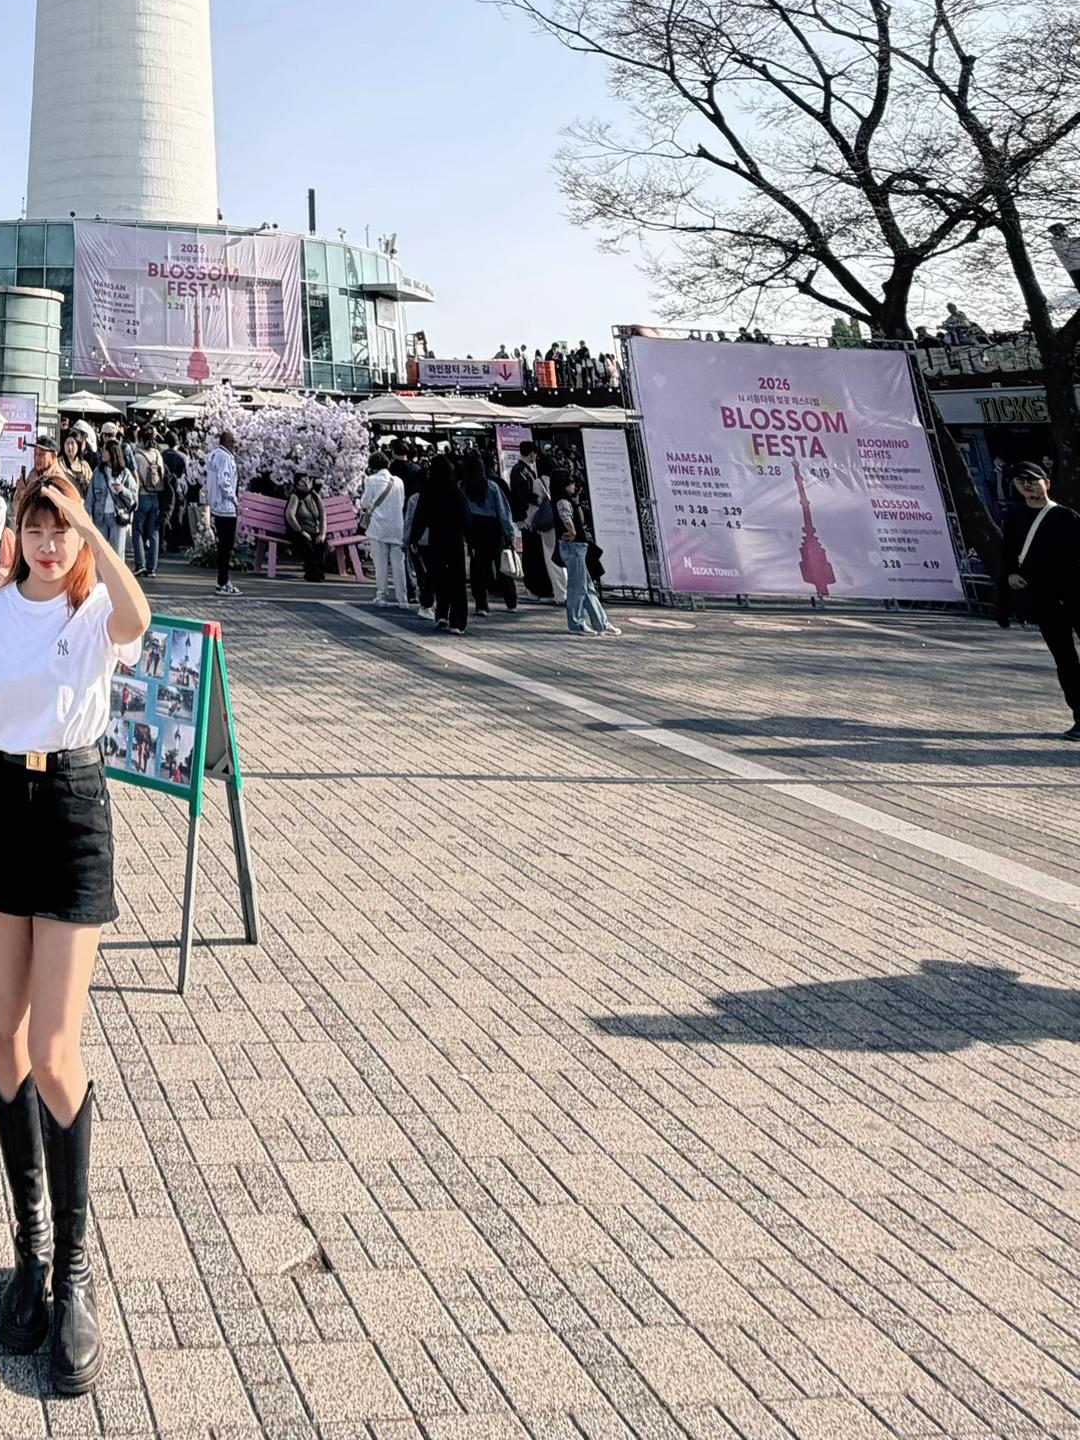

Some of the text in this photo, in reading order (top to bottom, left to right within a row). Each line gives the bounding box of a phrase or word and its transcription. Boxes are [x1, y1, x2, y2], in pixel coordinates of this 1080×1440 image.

[181, 244, 205, 254] 2026
[148, 263, 240, 283] BLOSSOM
[93, 280, 126, 291] NAMSAN
[167, 282, 221, 300] FESTA
[113, 291, 130, 301] FAIR
[428, 364, 490, 375] 와인장터 가는 길
[758, 377, 791, 391] 2026
[746, 394, 776, 404] 서울타워
[974, 395, 1049, 423] TICKE
[720, 406, 849, 434] BLOSSOM
[751, 433, 828, 459] FESTA
[857, 438, 910, 449] BLOOMING
[666, 452, 713, 464] NAMSAN
[859, 450, 892, 460] LIGHTS
[668, 465, 721, 477] WINE FAIR
[757, 465, 831, 479] 3.28 4.19
[870, 499, 920, 510] BLOSSOM
[689, 505, 709, 514] 3.28
[723, 506, 742, 516] 3.29
[873, 510, 933, 521] VIEW DINING
[690, 519, 707, 528] 4.4
[726, 521, 741, 530] 4.5
[683, 556, 692, 568] N
[883, 560, 940, 569] 3.28 4.19
[57, 639, 69, 656] NY
